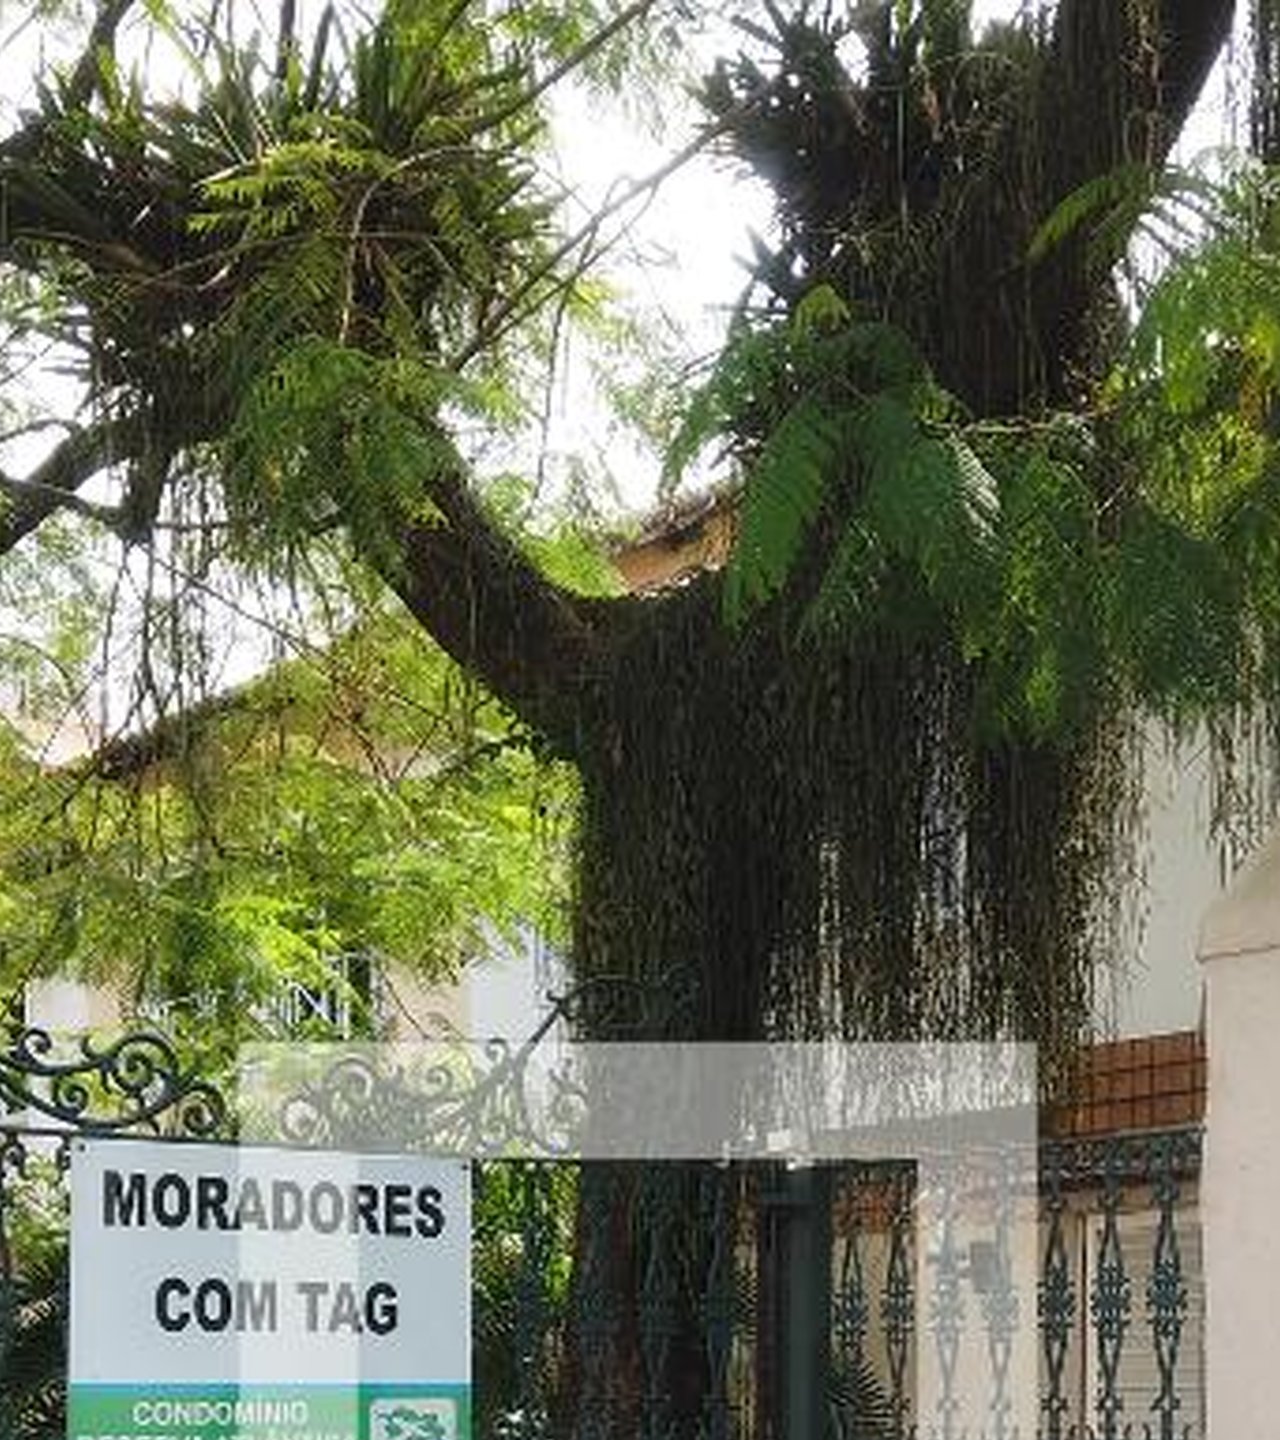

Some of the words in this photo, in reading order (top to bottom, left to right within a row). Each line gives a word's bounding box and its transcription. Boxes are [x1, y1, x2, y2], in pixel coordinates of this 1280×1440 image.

[102, 1169, 446, 1239] MORADORES
[154, 1277, 278, 1333] COM
[296, 1280, 399, 1335] TAG
